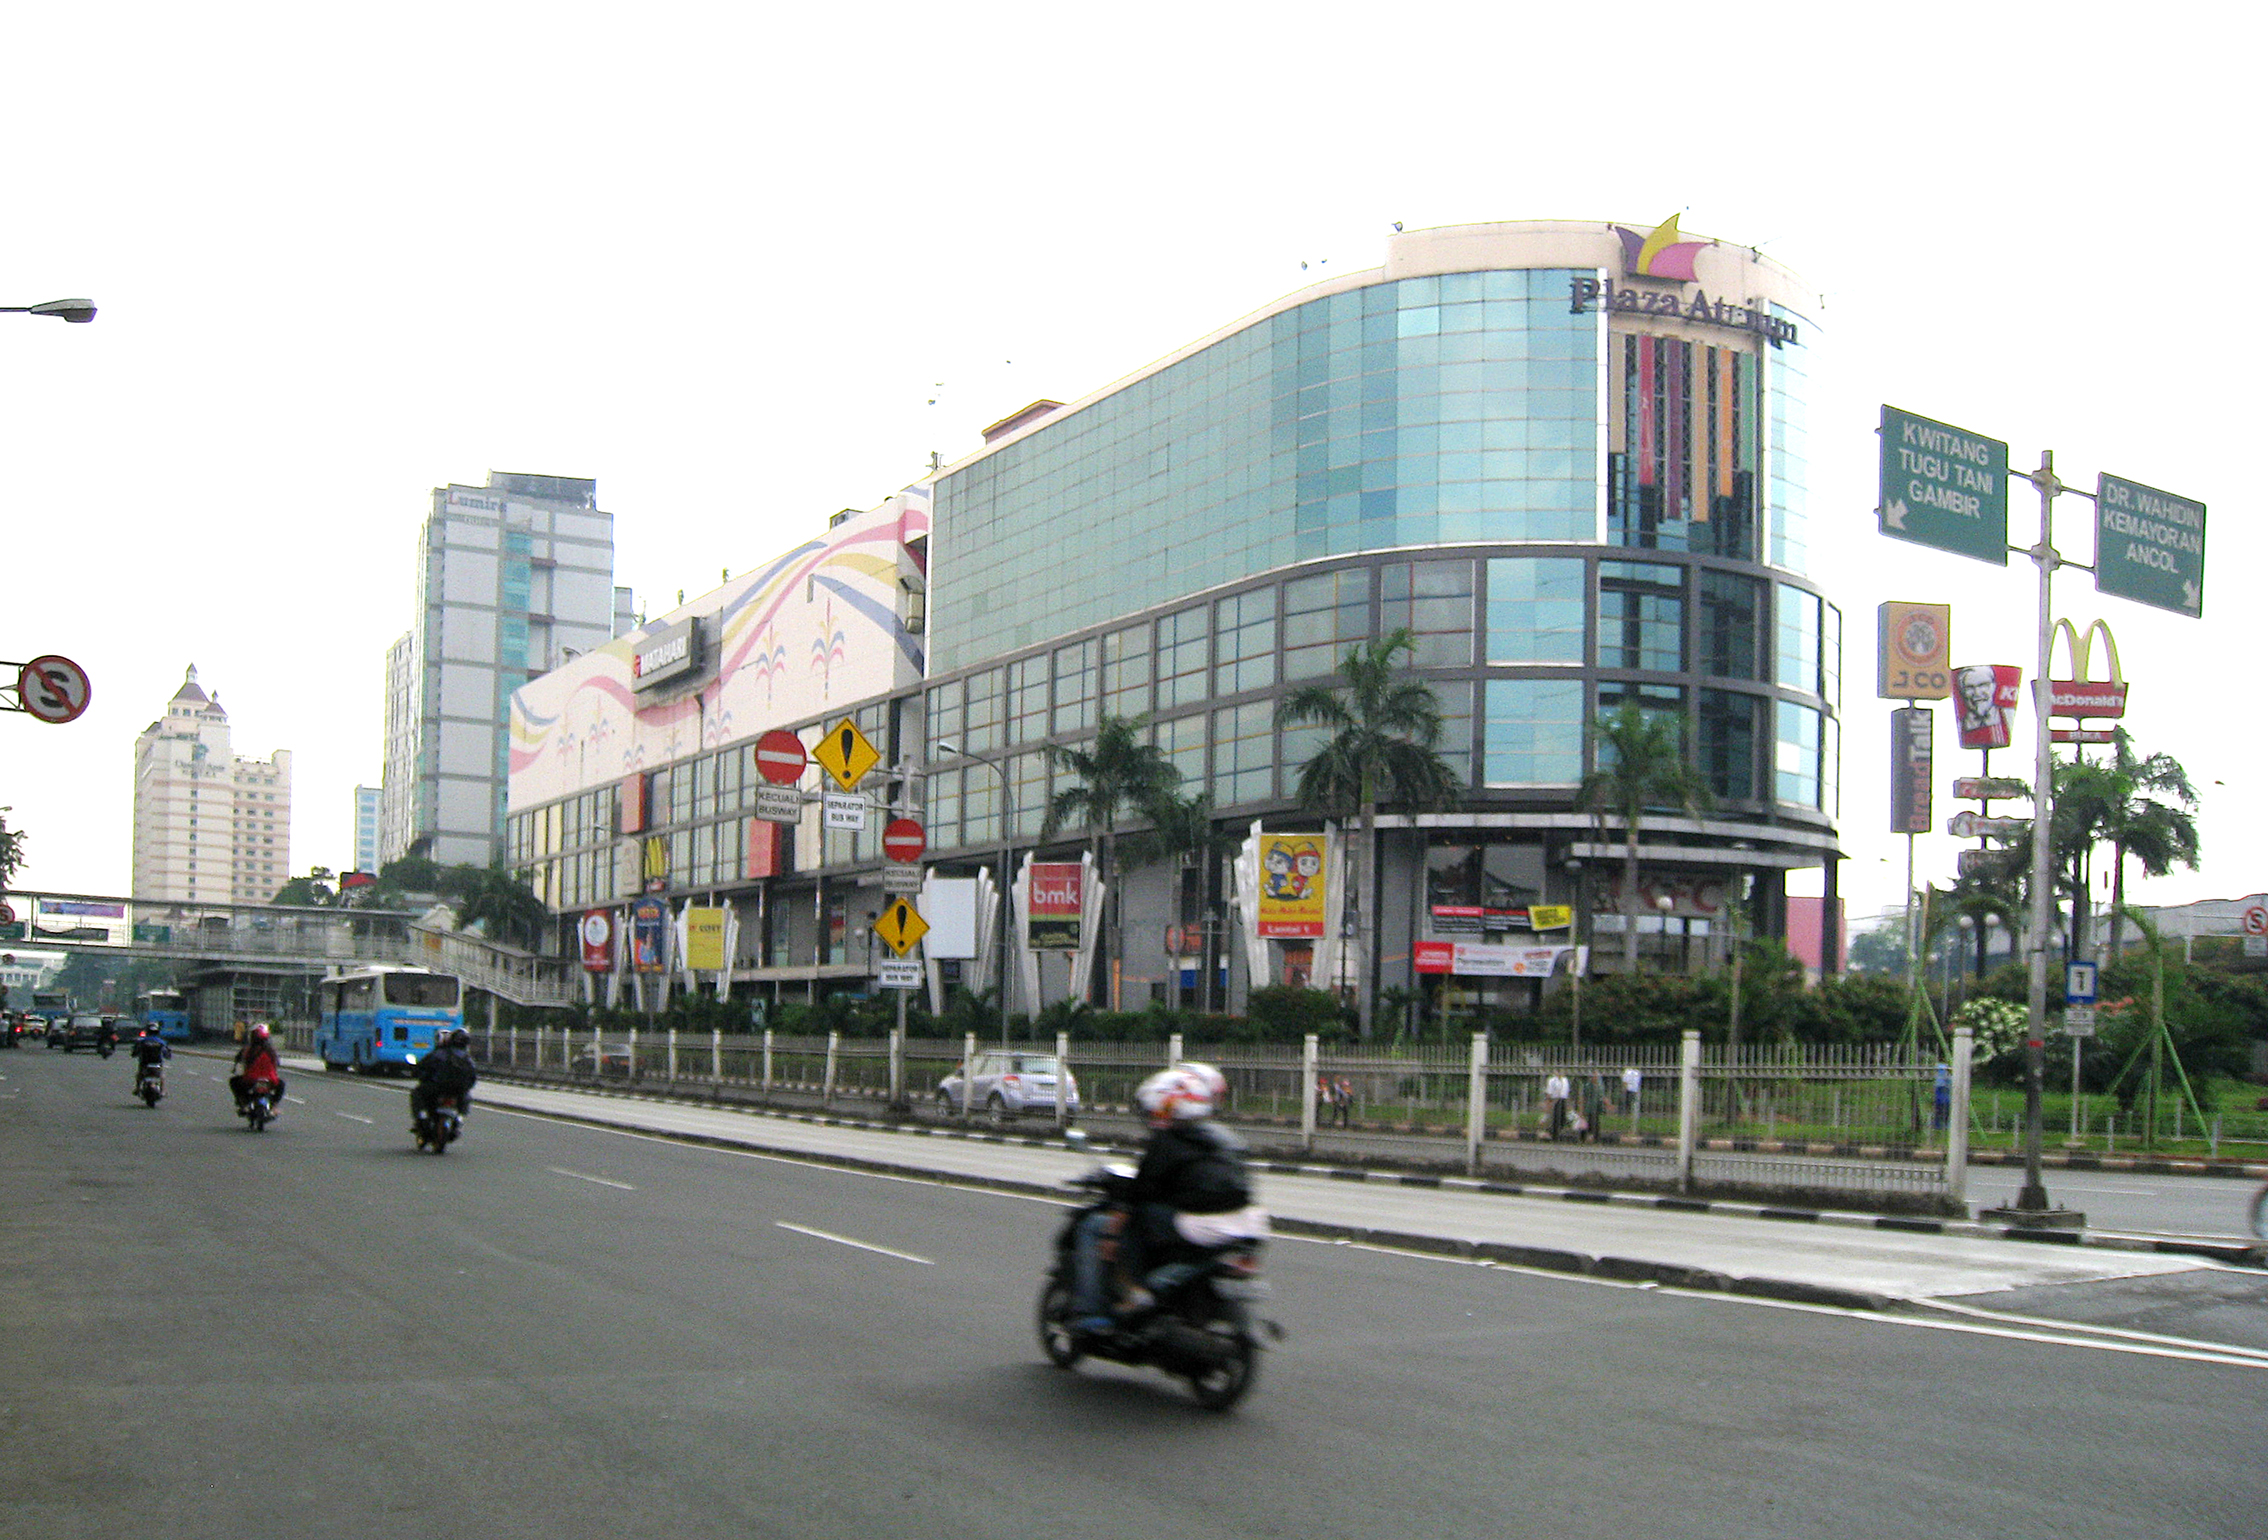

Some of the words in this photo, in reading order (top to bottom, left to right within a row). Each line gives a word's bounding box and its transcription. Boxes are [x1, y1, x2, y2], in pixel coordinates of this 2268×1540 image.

[1569, 276, 1680, 316] Plaza
[1687, 289, 1798, 350] Atrium
[1903, 420, 1990, 466] KWITANG
[1898, 448, 1950, 482] TUGU
[1955, 464, 1993, 495] TANI
[1909, 480, 1980, 519] GAMBIR
[2103, 508, 2201, 555] KEMAYORAN
[2125, 542, 2179, 574] ANCOL
[759, 805, 797, 816] BUSWAY
[1033, 881, 1079, 904] bmk
